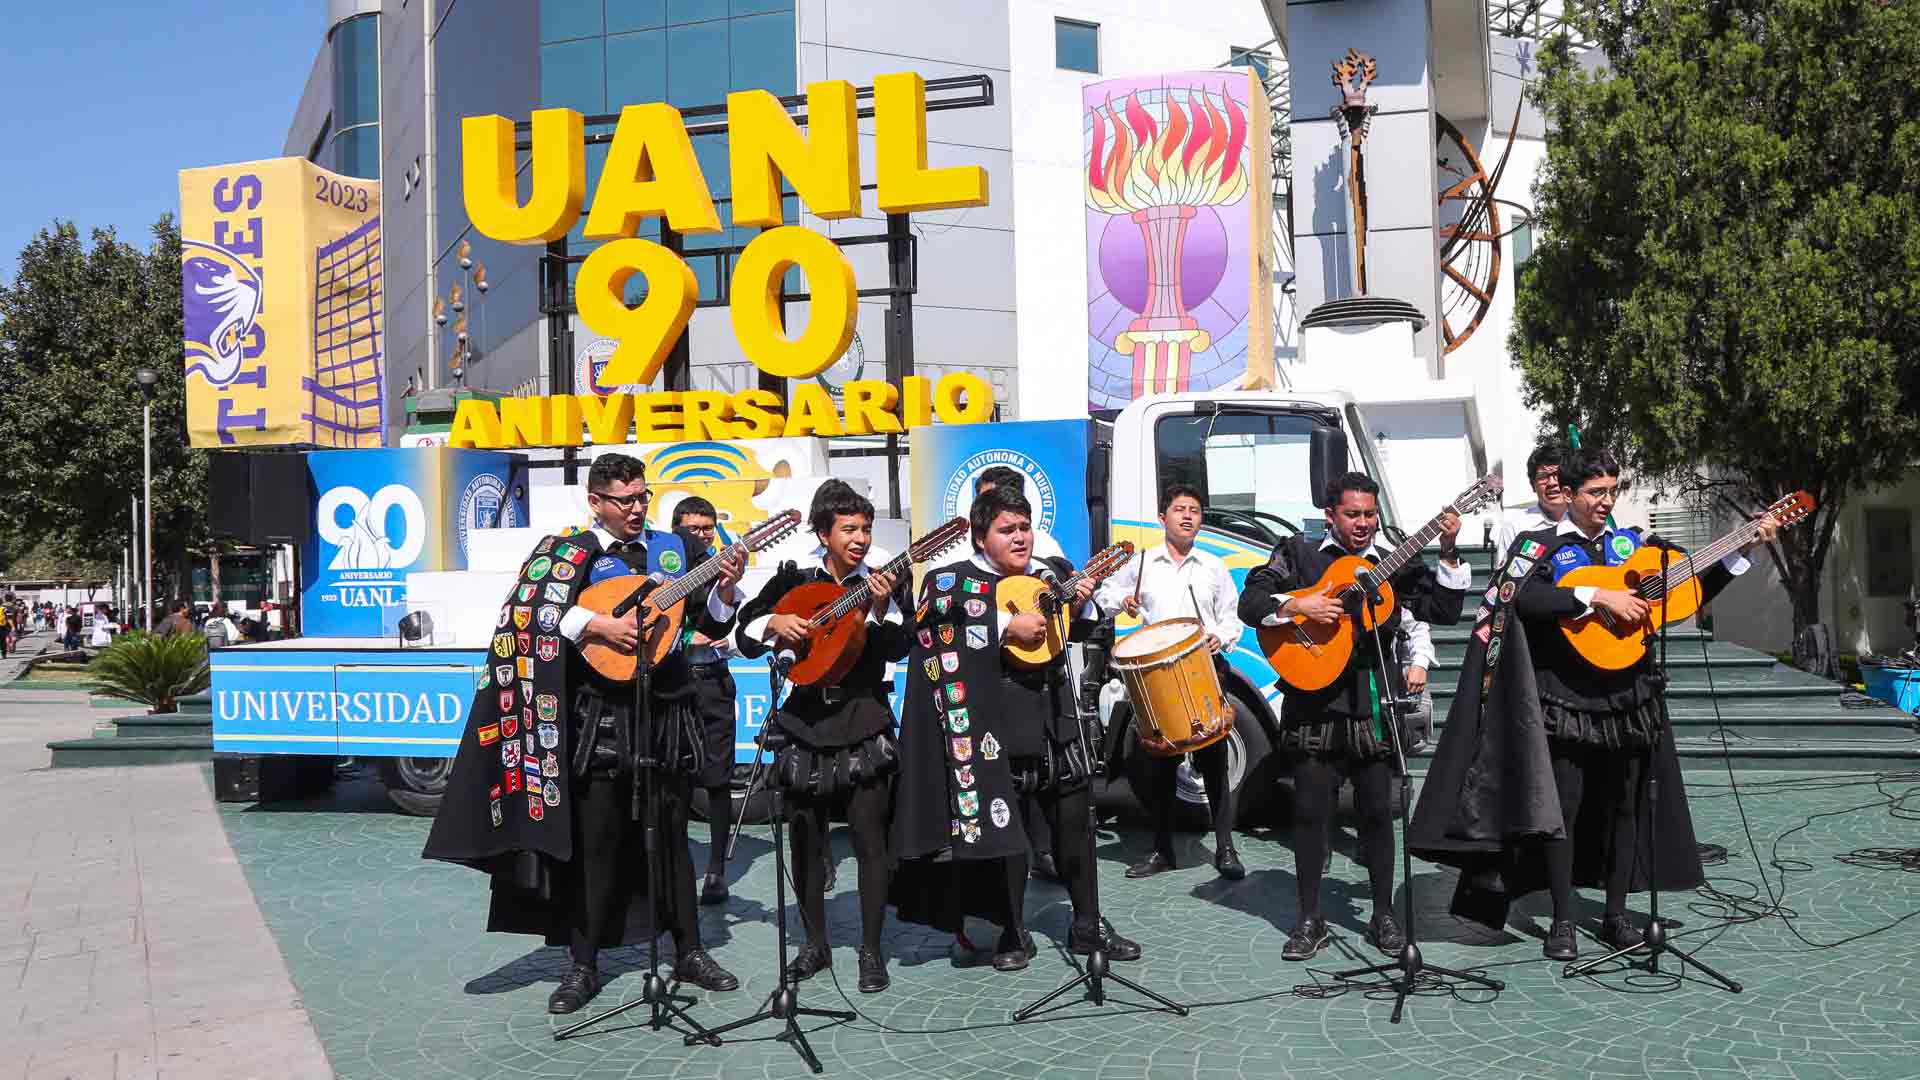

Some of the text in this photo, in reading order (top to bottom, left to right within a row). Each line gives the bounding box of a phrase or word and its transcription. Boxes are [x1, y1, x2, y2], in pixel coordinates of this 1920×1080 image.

[461, 72, 989, 244] UANL
[315, 174, 368, 213] 2023
[575, 225, 859, 386] 90
[447, 371, 995, 449] ANIVERSARIO
[967, 451, 1025, 473] AUTONOMA
[1033, 471, 1054, 509] NUEVO
[1556, 550, 1577, 562] UANL
[339, 586, 401, 608] UANL
[218, 690, 463, 725] UNIVERSIDAD
